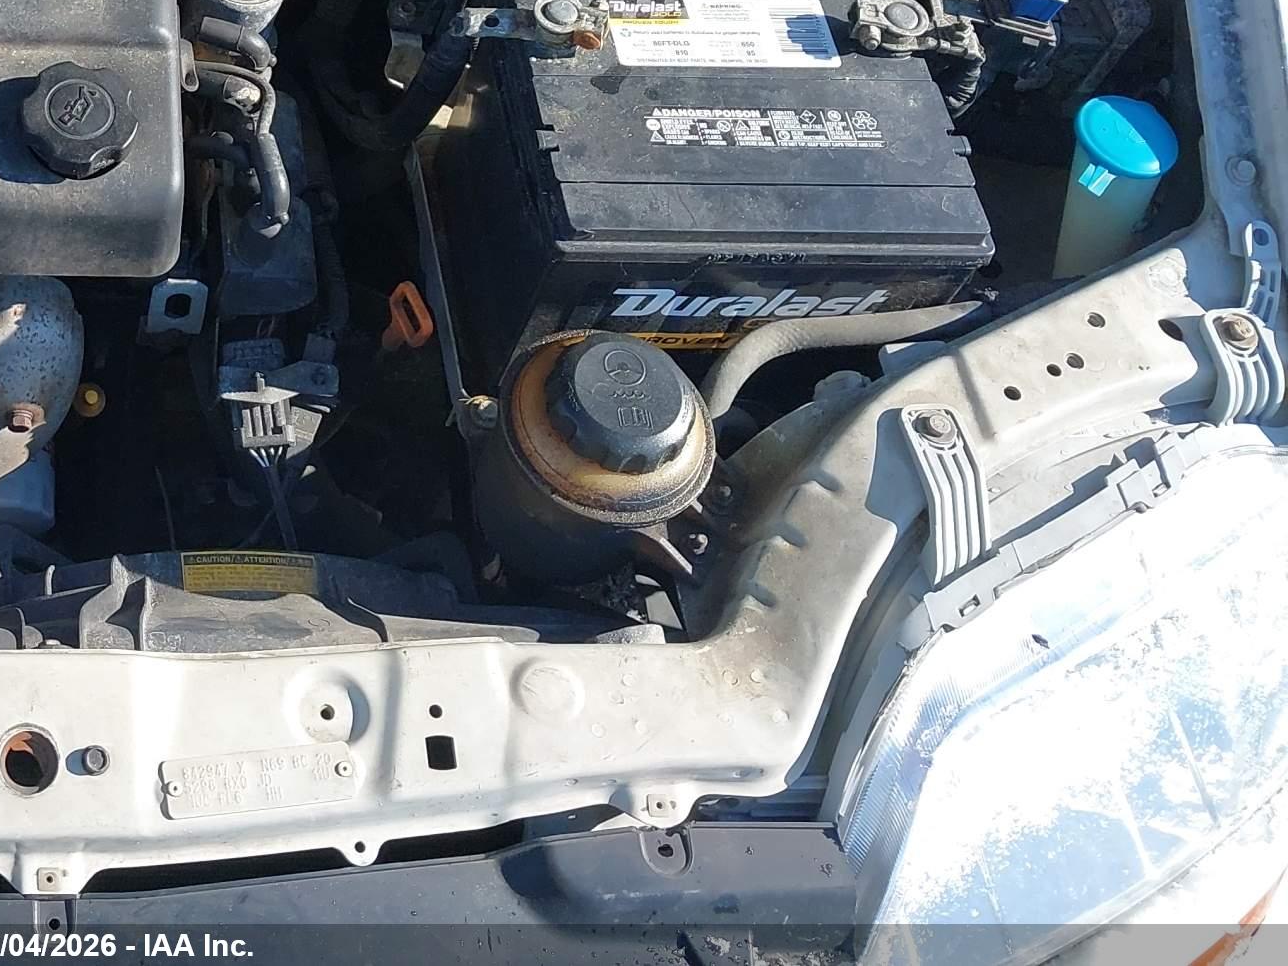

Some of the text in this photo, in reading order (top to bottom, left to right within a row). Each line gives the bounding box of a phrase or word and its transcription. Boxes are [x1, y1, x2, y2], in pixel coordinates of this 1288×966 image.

[609, 0, 683, 15] Duralast
[662, 108, 761, 118] DANGER/POISON
[611, 288, 892, 318] Duralast
